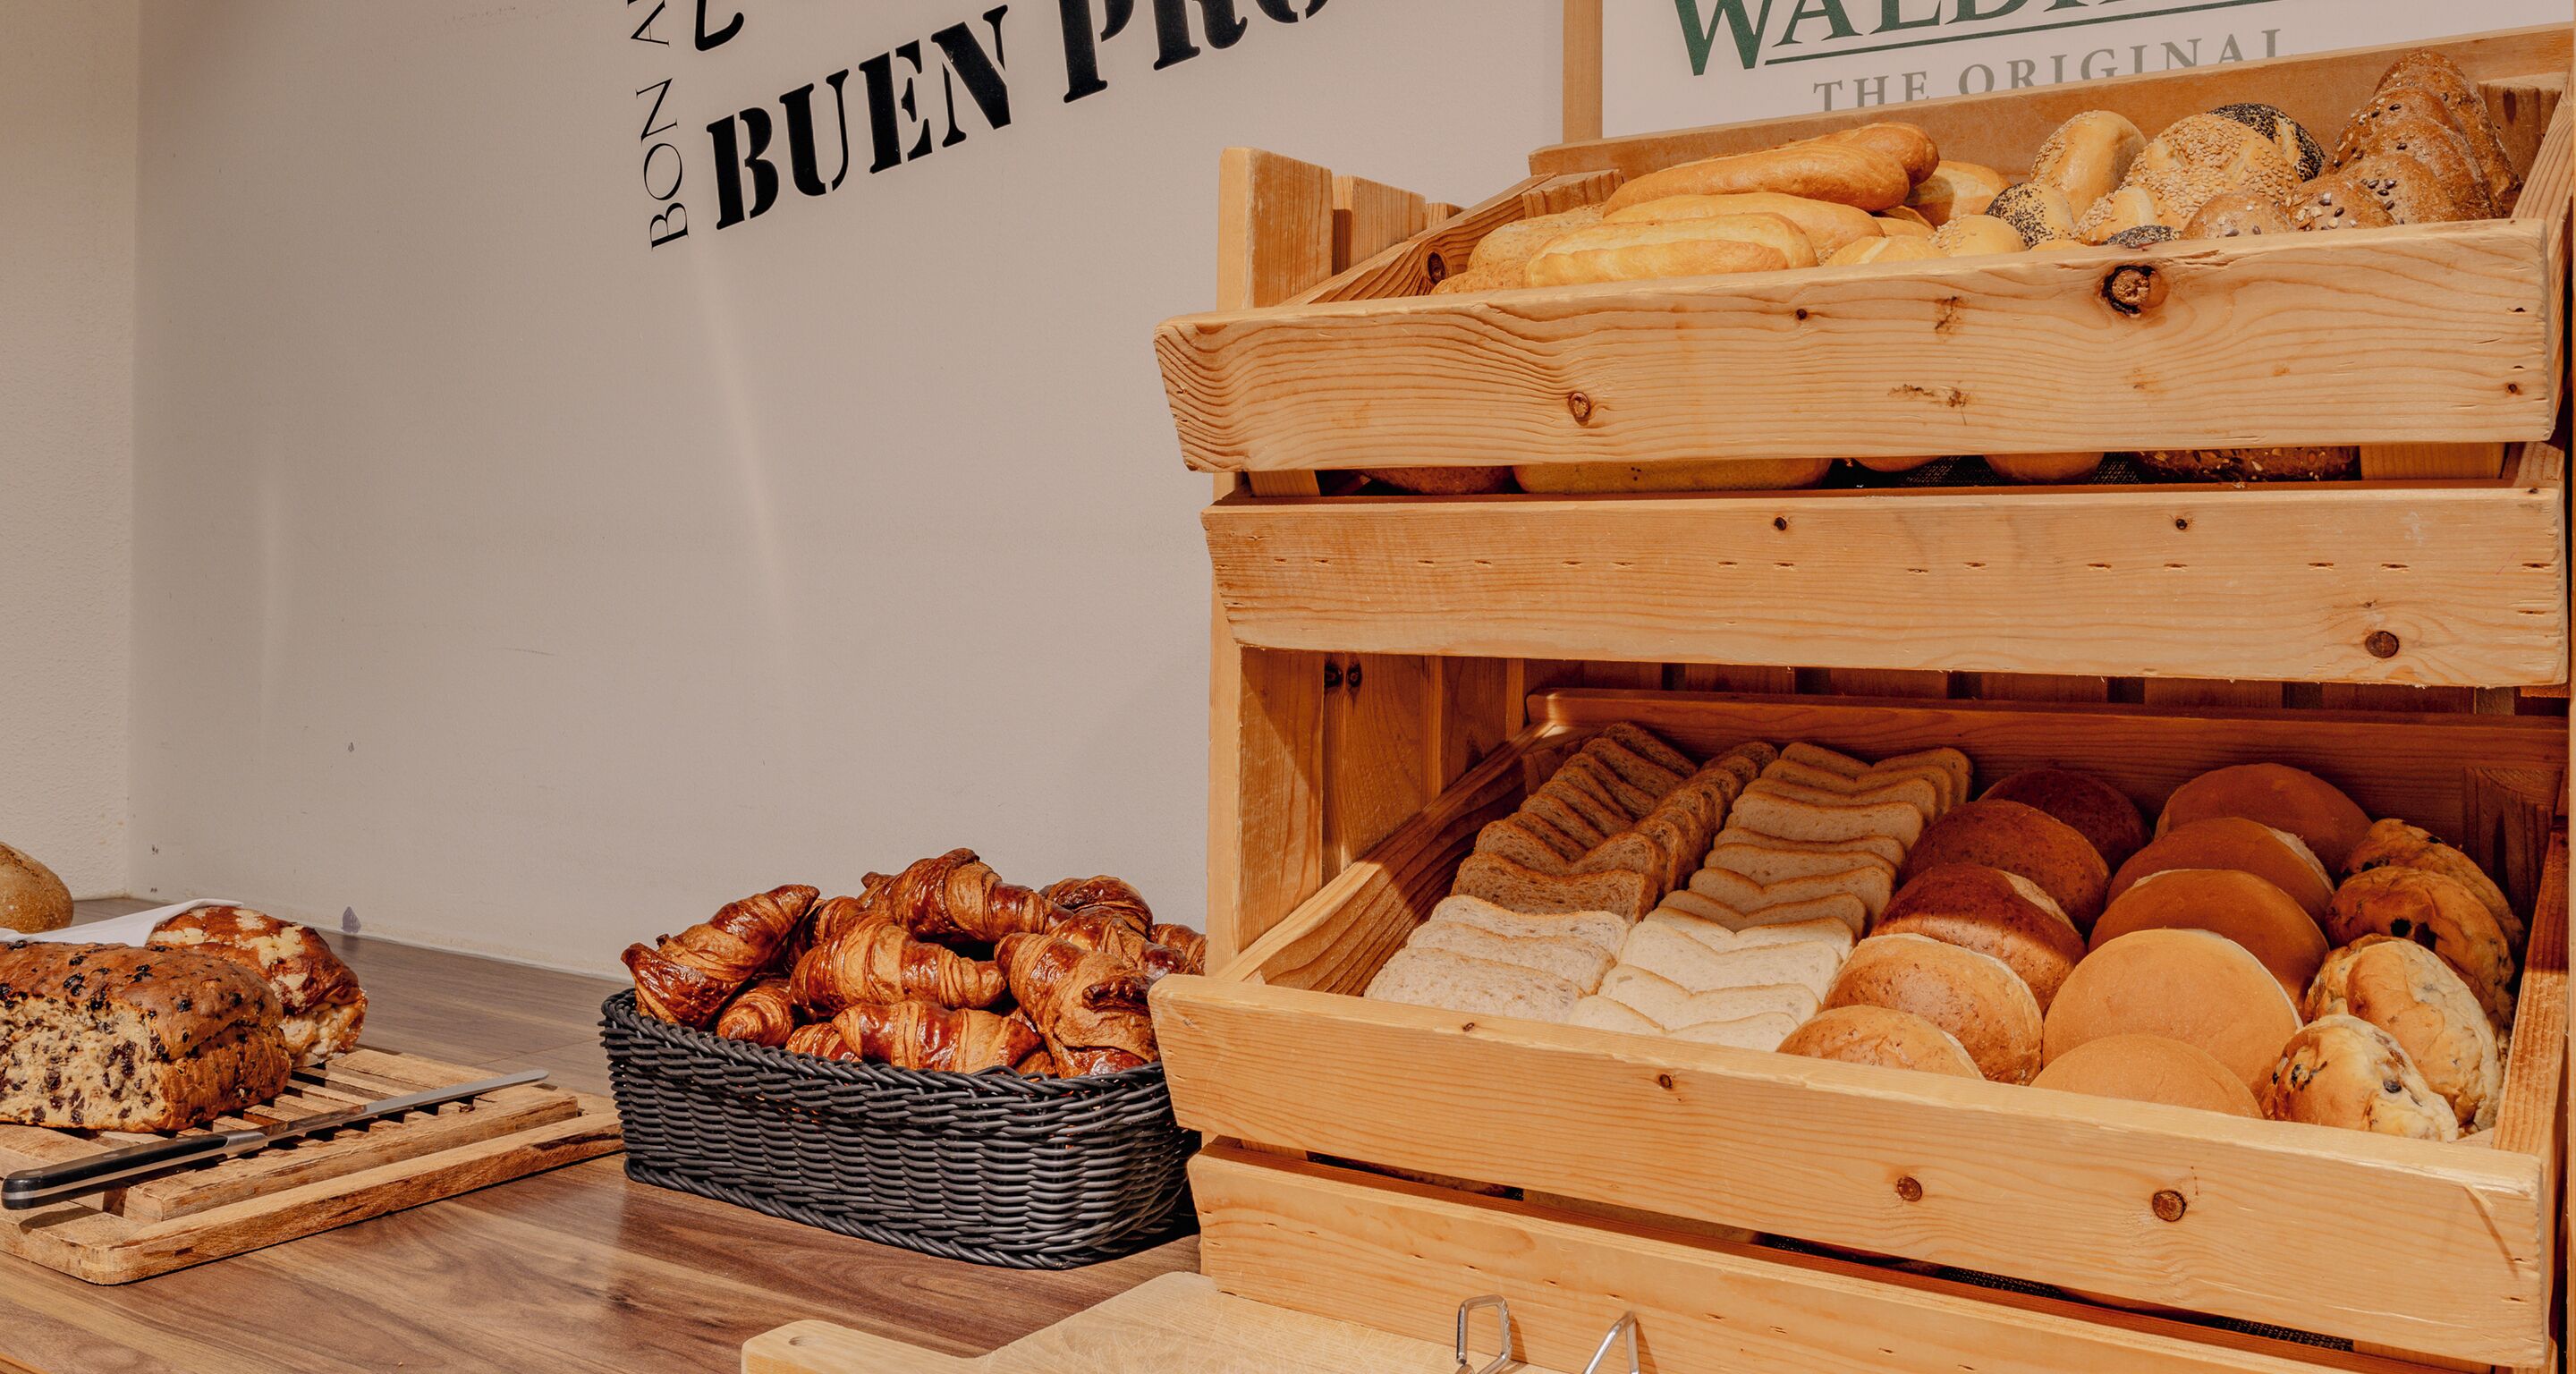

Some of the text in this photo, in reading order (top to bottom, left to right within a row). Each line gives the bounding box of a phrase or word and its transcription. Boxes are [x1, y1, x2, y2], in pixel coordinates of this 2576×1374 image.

[635, 77, 689, 251] BON
[706, 4, 1013, 231] BUEN
[1813, 71, 1930, 113] THE
